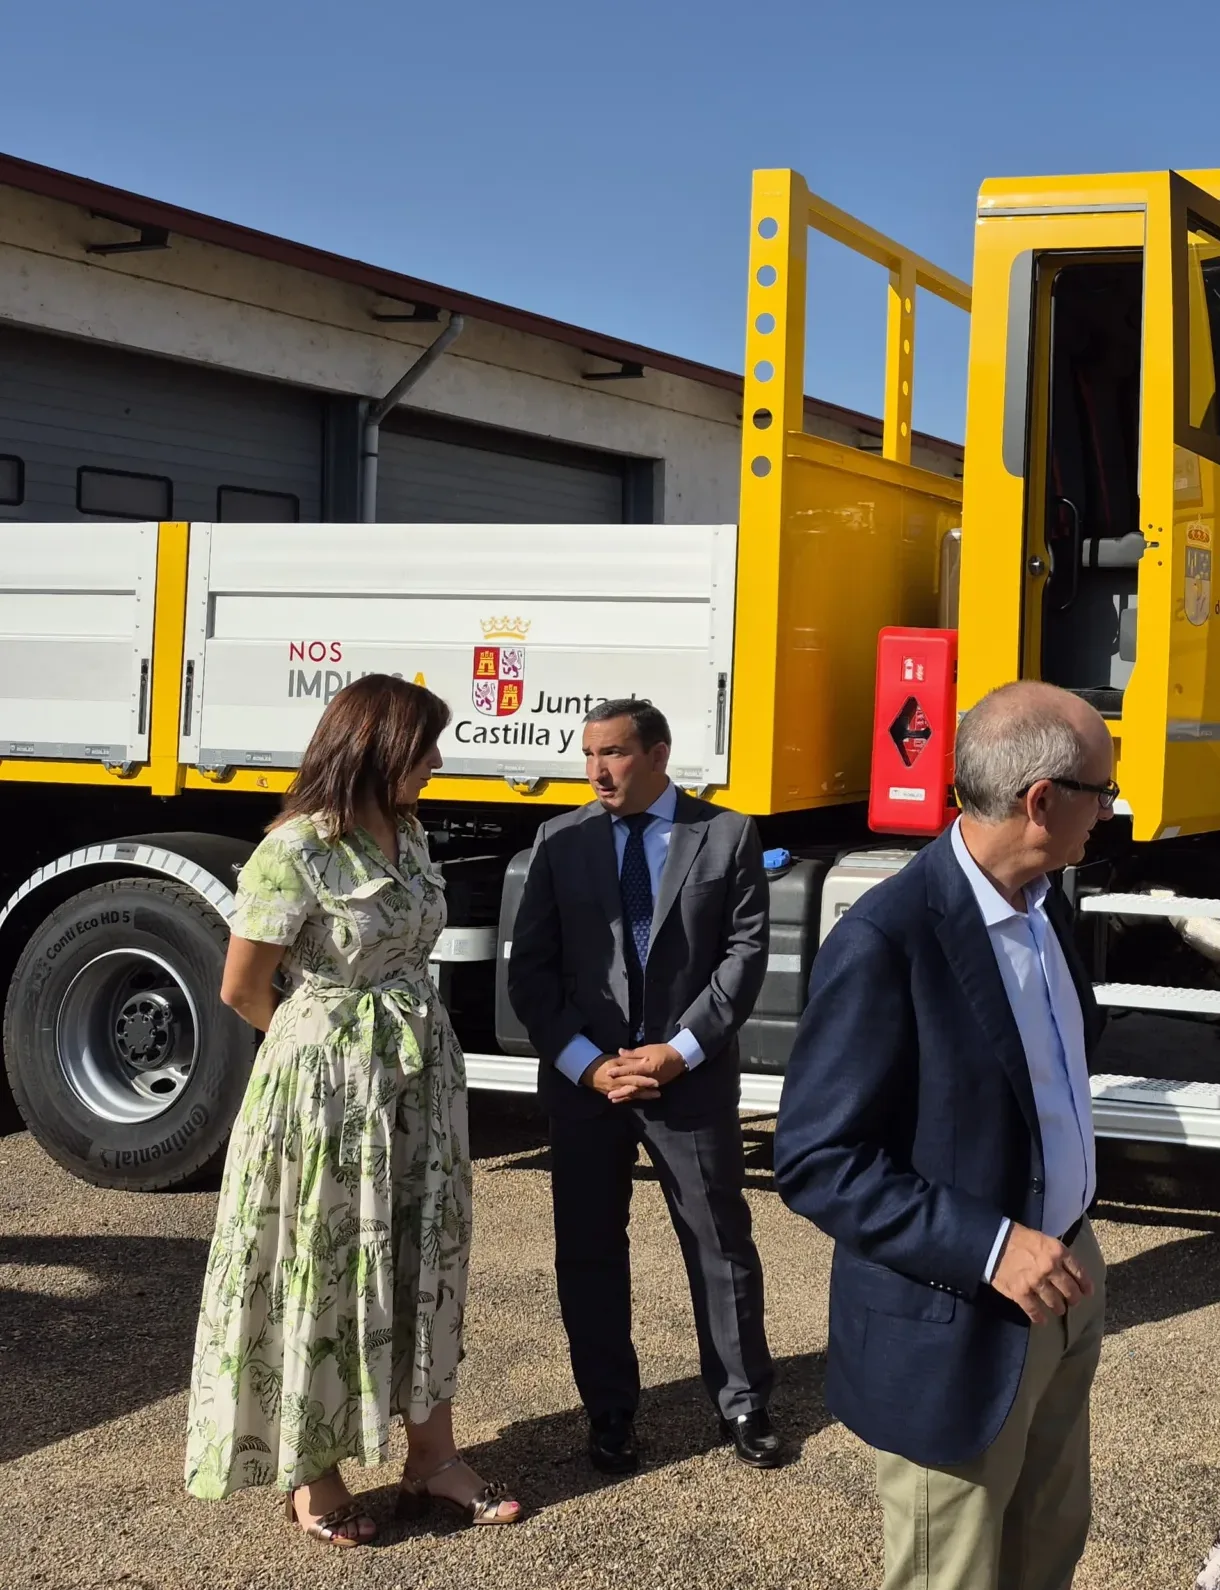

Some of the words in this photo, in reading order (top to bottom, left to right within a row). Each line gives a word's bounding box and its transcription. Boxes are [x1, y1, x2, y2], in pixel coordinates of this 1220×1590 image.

[289, 641, 342, 662] NOS
[455, 720, 550, 746] Castilla
[557, 728, 575, 753] y
[46, 927, 77, 960] Conti
[76, 918, 99, 935] Eco
[100, 910, 120, 925] HD
[122, 910, 131, 923] 5
[115, 1104, 209, 1169] Continental
